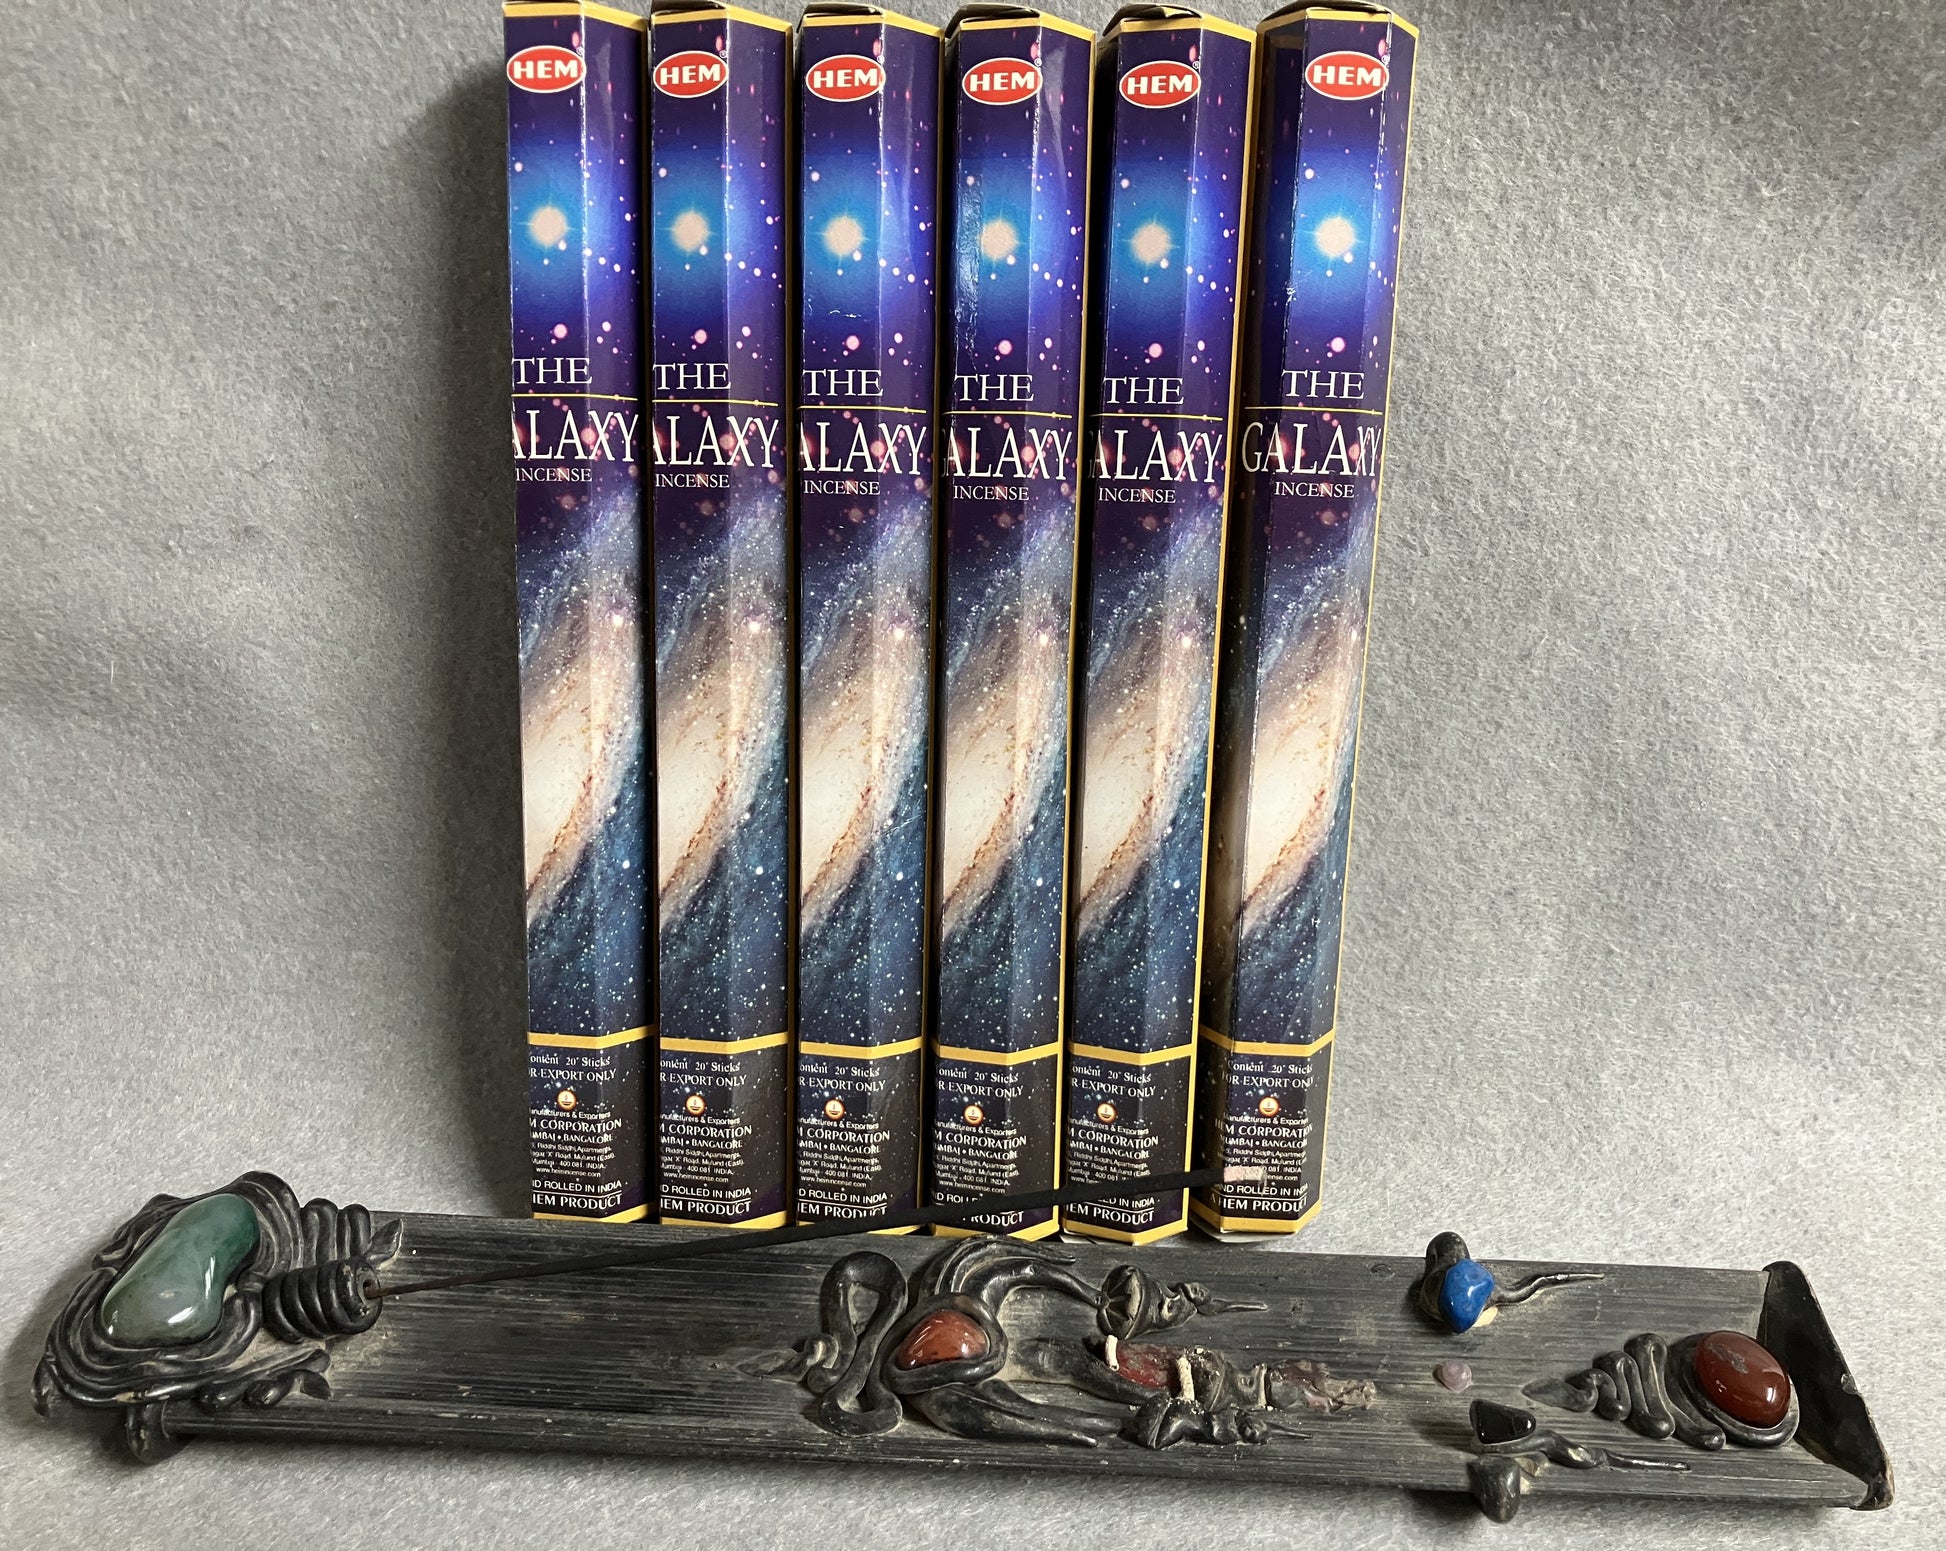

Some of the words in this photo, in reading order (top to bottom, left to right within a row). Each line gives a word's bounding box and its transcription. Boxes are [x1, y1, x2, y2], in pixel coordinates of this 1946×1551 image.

[513, 58, 579, 79] HEM
[659, 62, 721, 85] HEM
[1312, 65, 1381, 86] HEM
[812, 68, 879, 88] HEM
[969, 72, 1035, 91] HEM
[1127, 75, 1194, 94] HEM
[511, 357, 593, 385] THE
[652, 363, 732, 390] THE
[802, 369, 884, 397] THE
[954, 374, 1035, 402] THE
[1103, 377, 1184, 405] THE
[1282, 370, 1365, 400] THE
[511, 409, 639, 462] LAXY
[652, 415, 779, 468] LAXY
[798, 422, 927, 475] ALAXY
[943, 427, 1072, 480] ALAXY
[1088, 430, 1223, 483] ALAXY
[1242, 422, 1382, 477] GALAXY
[516, 468, 593, 482] INCENSE
[655, 473, 730, 488] INCENSE
[803, 480, 881, 495] INCENSE
[953, 486, 1029, 501] INCENSE
[1274, 481, 1355, 498] INCENSE
[1099, 488, 1176, 504] INCENSE
[530, 1055, 559, 1065] ontent
[660, 1060, 688, 1070] ontent
[540, 1068, 585, 1081] EXPORT
[586, 1068, 616, 1081] ONLY
[800, 1063, 828, 1074] ontent
[939, 1068, 967, 1079] ontent
[1072, 1066, 1101, 1077] ontent
[669, 1073, 713, 1086] EXPORT
[716, 1074, 747, 1087] ONLY
[809, 1077, 853, 1091] EXPORT
[855, 1080, 886, 1092] ONLY
[1081, 1079, 1125, 1095] EXPORT
[1128, 1086, 1156, 1097] ONLY
[1243, 1076, 1290, 1088] EXPORT
[948, 1082, 993, 1096] EXPORT
[995, 1085, 1023, 1098] ONLY
[540, 1118, 622, 1133] CORPORATION
[668, 1124, 752, 1138] CORPORATION
[839, 1121, 845, 1129] &
[807, 1129, 890, 1144] CORPORATION
[945, 1134, 1027, 1150] CORPORATION
[1078, 1129, 1159, 1149] CORPORATION
[544, 1181, 582, 1192] ROLLED
[584, 1184, 593, 1193] IN
[597, 1180, 622, 1193] INDIA
[671, 1185, 710, 1197] ROLLED
[712, 1189, 722, 1198] IN
[725, 1187, 751, 1199] INDIA
[1237, 1185, 1277, 1195] ROLLED
[1280, 1188, 1290, 1196] IN
[560, 1194, 623, 1210] PRODUCT
[809, 1190, 847, 1202] ROLLED
[850, 1194, 860, 1203] IN
[863, 1192, 887, 1204] INDIA
[1120, 1198, 1130, 1207] IN
[1132, 1197, 1155, 1209] INDIA
[687, 1201, 752, 1216] PRODUCT
[1093, 1207, 1155, 1225] PRODUCT
